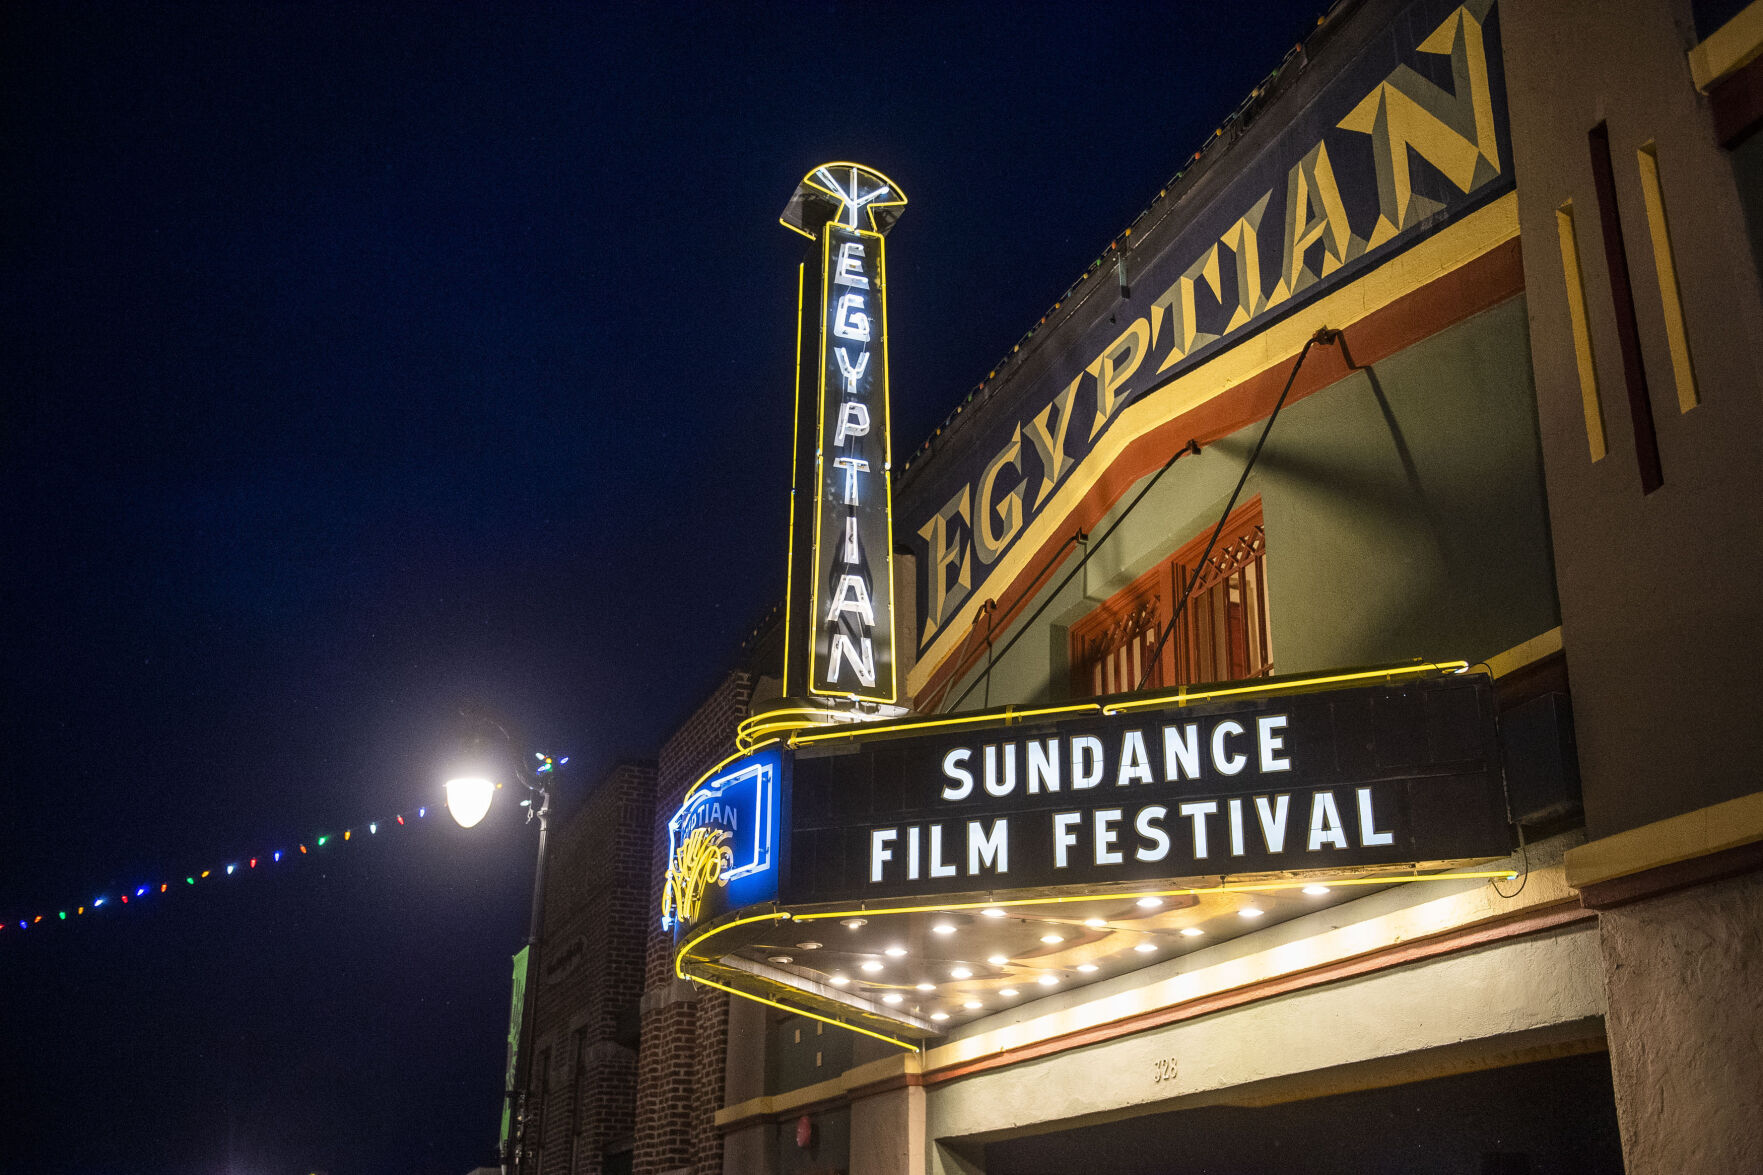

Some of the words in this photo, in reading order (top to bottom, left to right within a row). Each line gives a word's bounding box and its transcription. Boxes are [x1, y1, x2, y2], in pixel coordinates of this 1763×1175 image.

[917, 0, 1500, 648] EGYPTIAN
[828, 243, 875, 687] EGYPTIAN
[942, 715, 1291, 800] SUNDANCE
[870, 819, 1008, 883] FILM
[1053, 786, 1394, 869] FESTIVAL
[1153, 1056, 1178, 1083] 328
